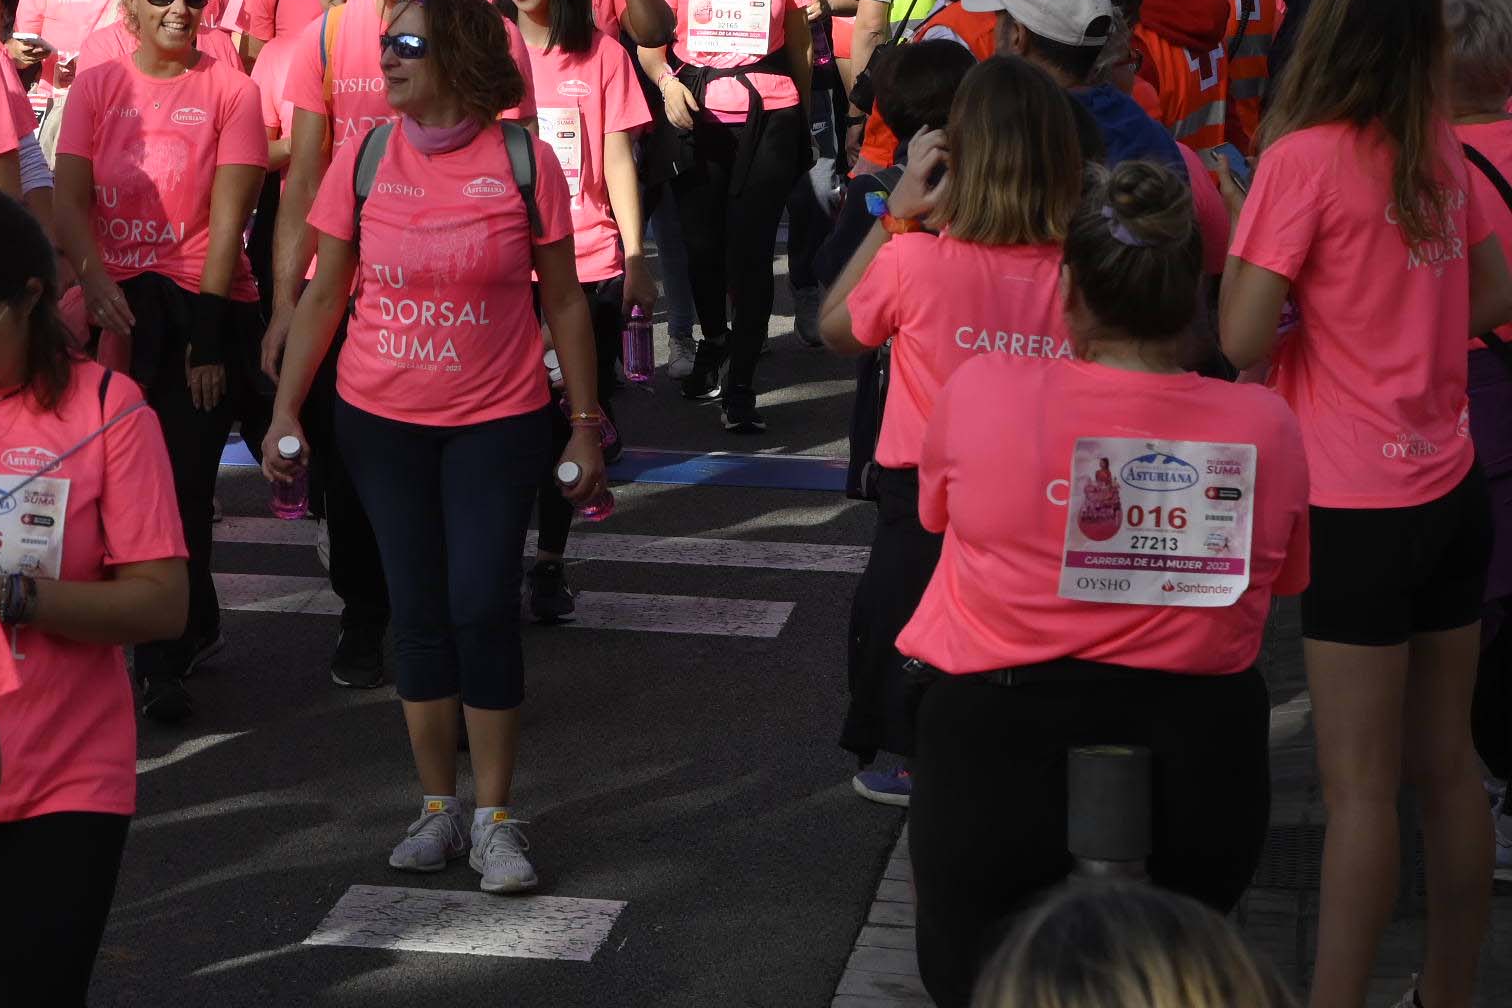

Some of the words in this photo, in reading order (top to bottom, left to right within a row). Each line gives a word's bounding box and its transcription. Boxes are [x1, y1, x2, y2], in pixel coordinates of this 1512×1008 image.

[715, 9, 742, 20] 016
[377, 183, 425, 198] OYSHO
[371, 263, 405, 290] TU
[378, 297, 490, 328] DORSAL
[376, 329, 460, 363] SUMA
[954, 325, 1075, 360] CARRERA
[1125, 467, 1193, 485] ASTURIANA
[1206, 465, 1241, 476] SUMA
[24, 495, 56, 507] SUMA
[1127, 504, 1188, 530] 016
[1130, 535, 1179, 551] 27213
[1084, 555, 1132, 567] CARRERA
[1133, 558, 1148, 568] DE
[1149, 558, 1164, 568] LA
[1165, 559, 1203, 570] MUJER
[1205, 562, 1230, 571] 2023
[1076, 576, 1131, 592] OYSHO
[1176, 581, 1233, 595] Santander
